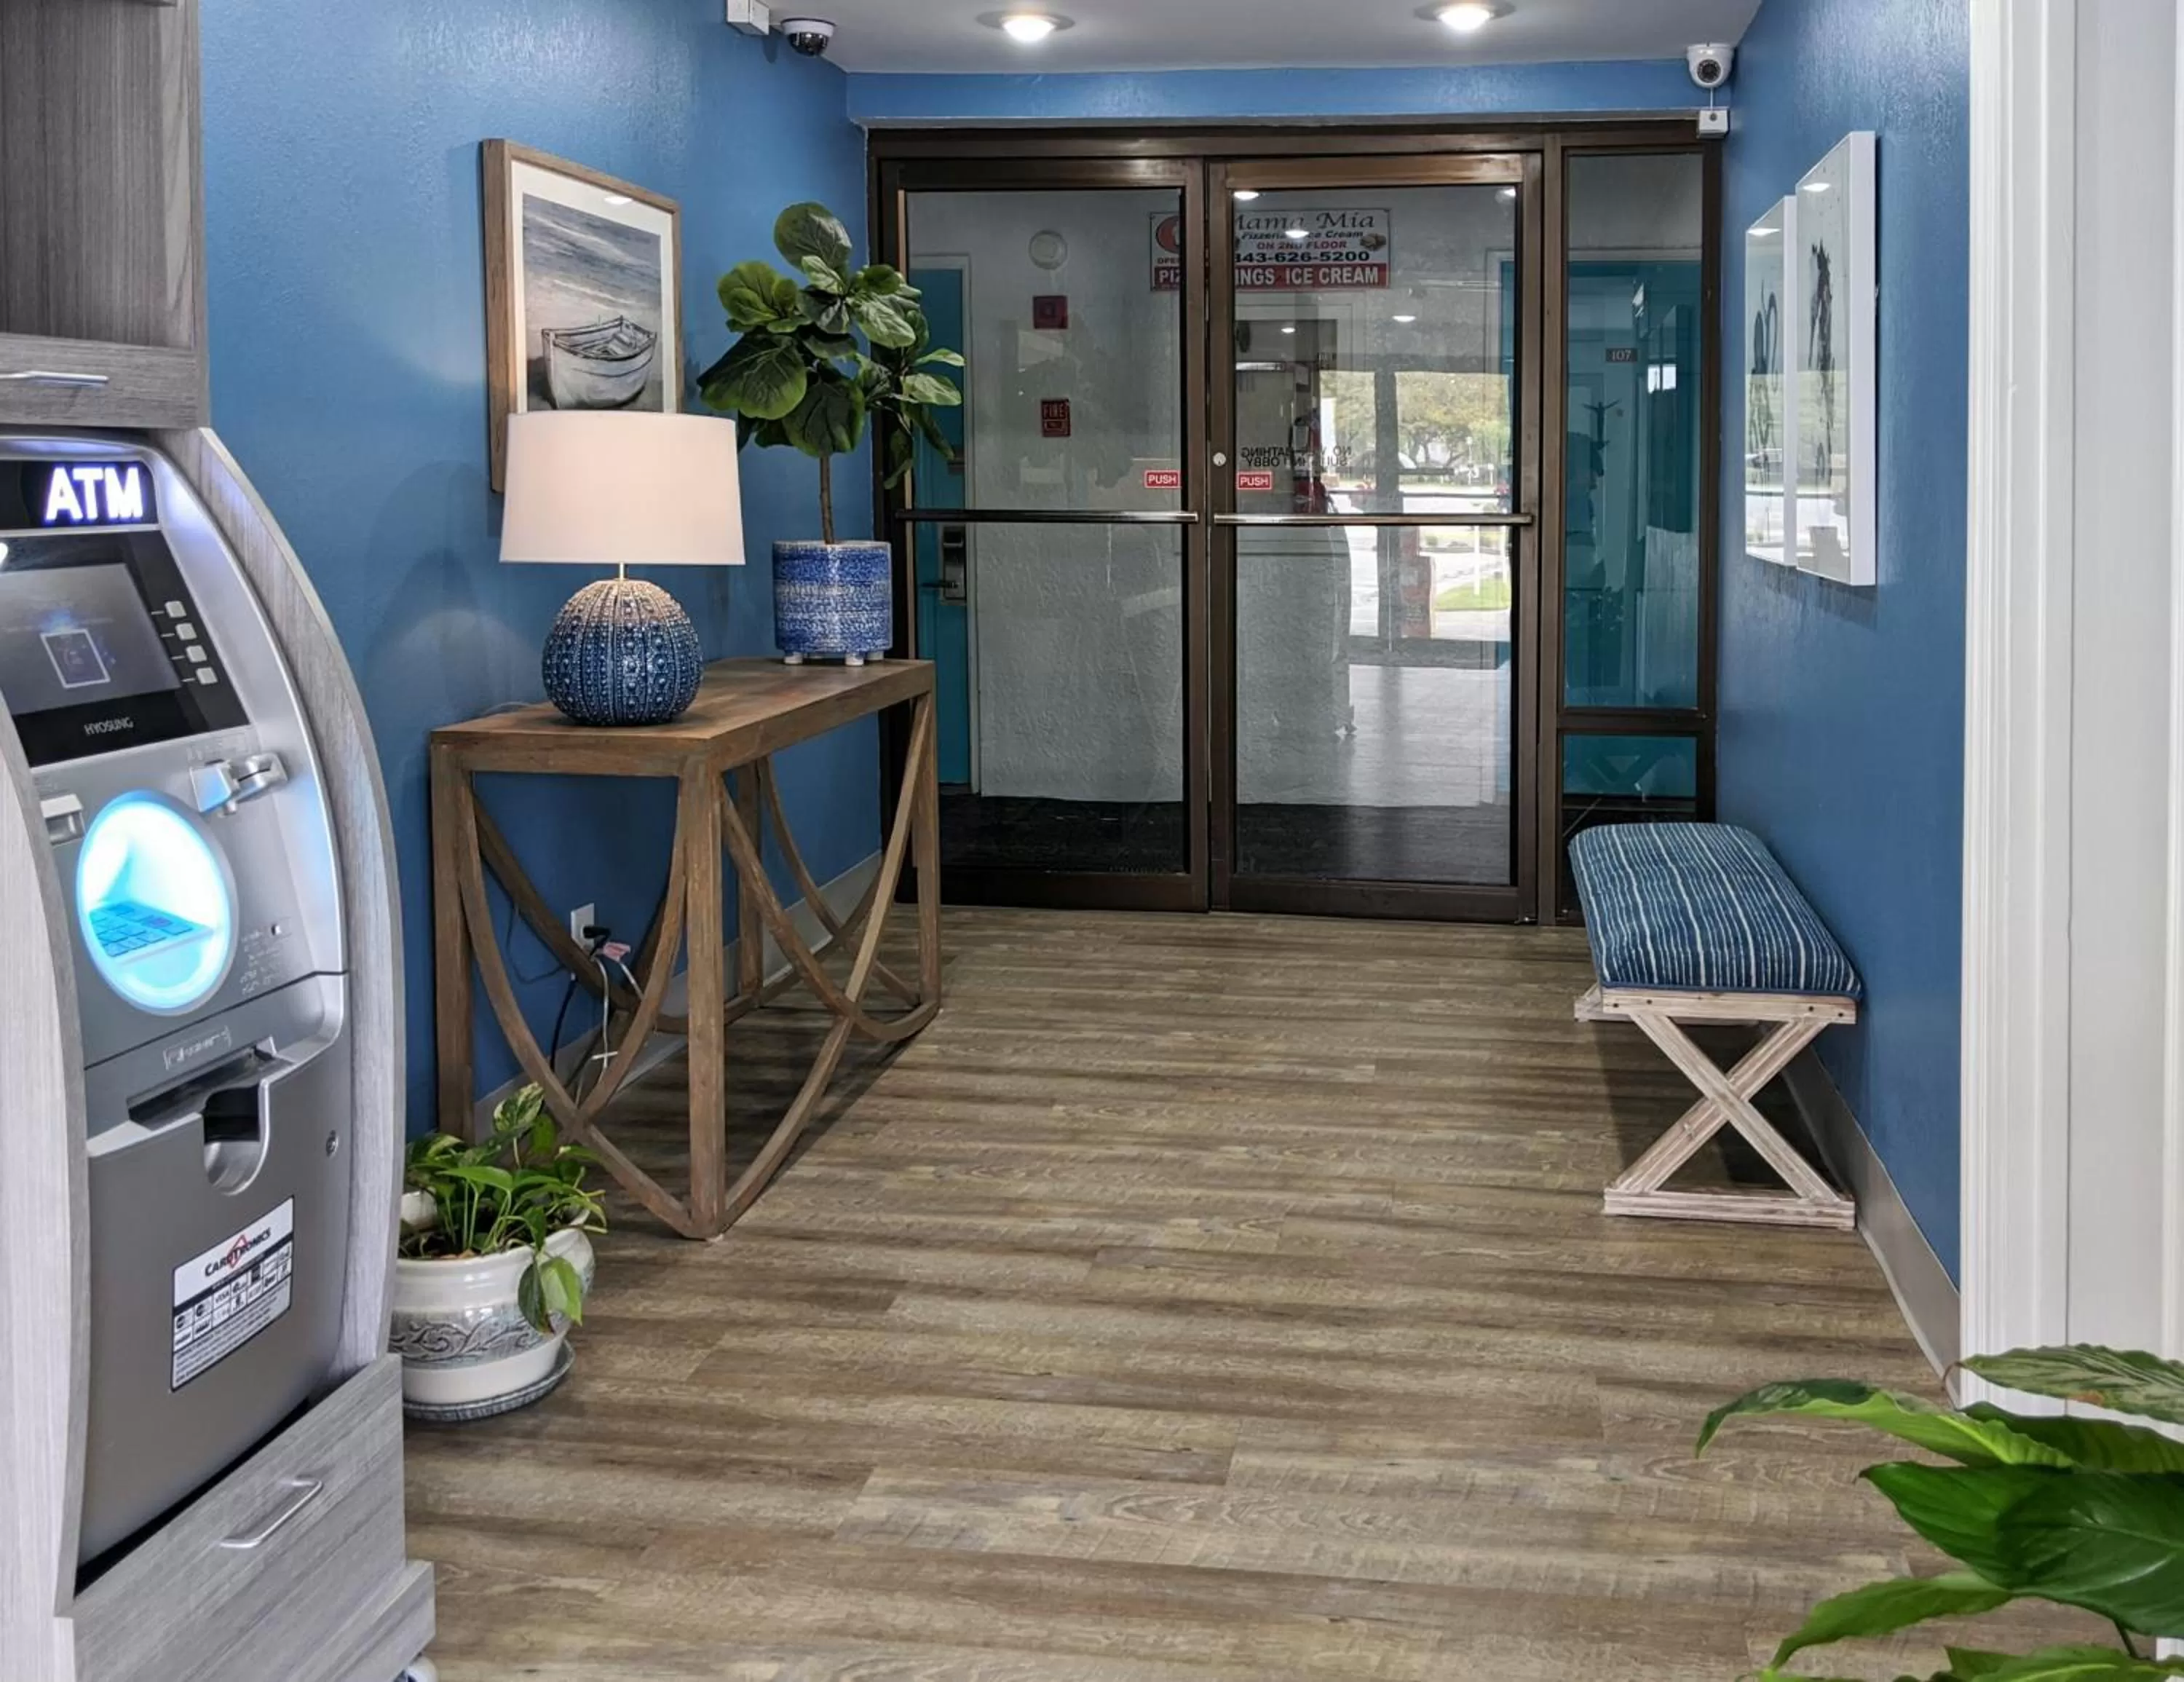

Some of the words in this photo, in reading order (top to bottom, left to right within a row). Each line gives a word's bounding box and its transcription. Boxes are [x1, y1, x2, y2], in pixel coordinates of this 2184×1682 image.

[1316, 211, 1375, 229] Mia
[1326, 230, 1364, 238] Cream
[1257, 241, 1275, 250] ON
[1306, 240, 1348, 250] FLOOR
[1235, 268, 1275, 285] INGS
[1286, 267, 1314, 285] ICE
[1319, 266, 1379, 285] CREAM
[1611, 350, 1631, 361] 107
[1147, 475, 1177, 485] PUSH
[1240, 476, 1269, 486] PUSH
[45, 466, 145, 521] ATM
[84, 716, 134, 735] HYOSUNG
